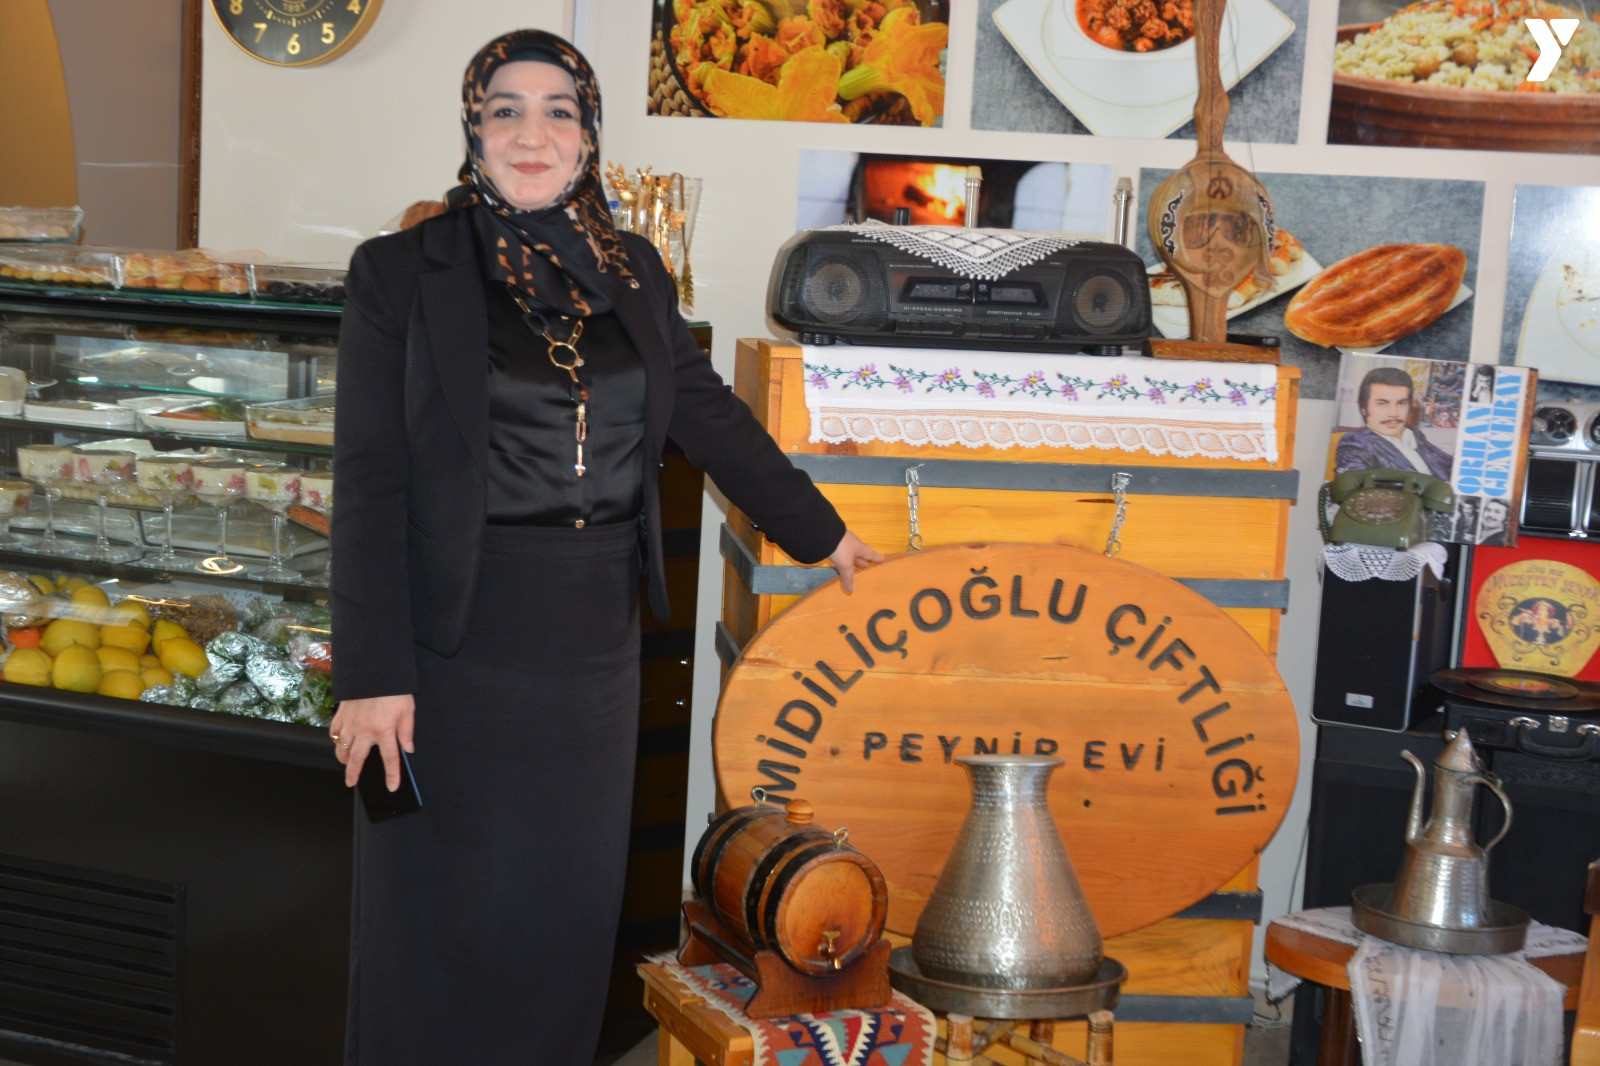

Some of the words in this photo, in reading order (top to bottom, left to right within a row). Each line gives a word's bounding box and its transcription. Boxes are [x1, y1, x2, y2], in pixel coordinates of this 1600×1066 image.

[253, 22, 268, 44] 7
[287, 33, 301, 55] 6
[321, 22, 336, 44] 5
[1456, 403, 1493, 494] ORHAN
[1484, 370, 1522, 497] GENCEBAY
[751, 566, 1089, 806] MİDİLİÇOĞLU
[1106, 604, 1267, 816] ÇİFTLİĞİ
[1083, 738, 1166, 772] EVİ
